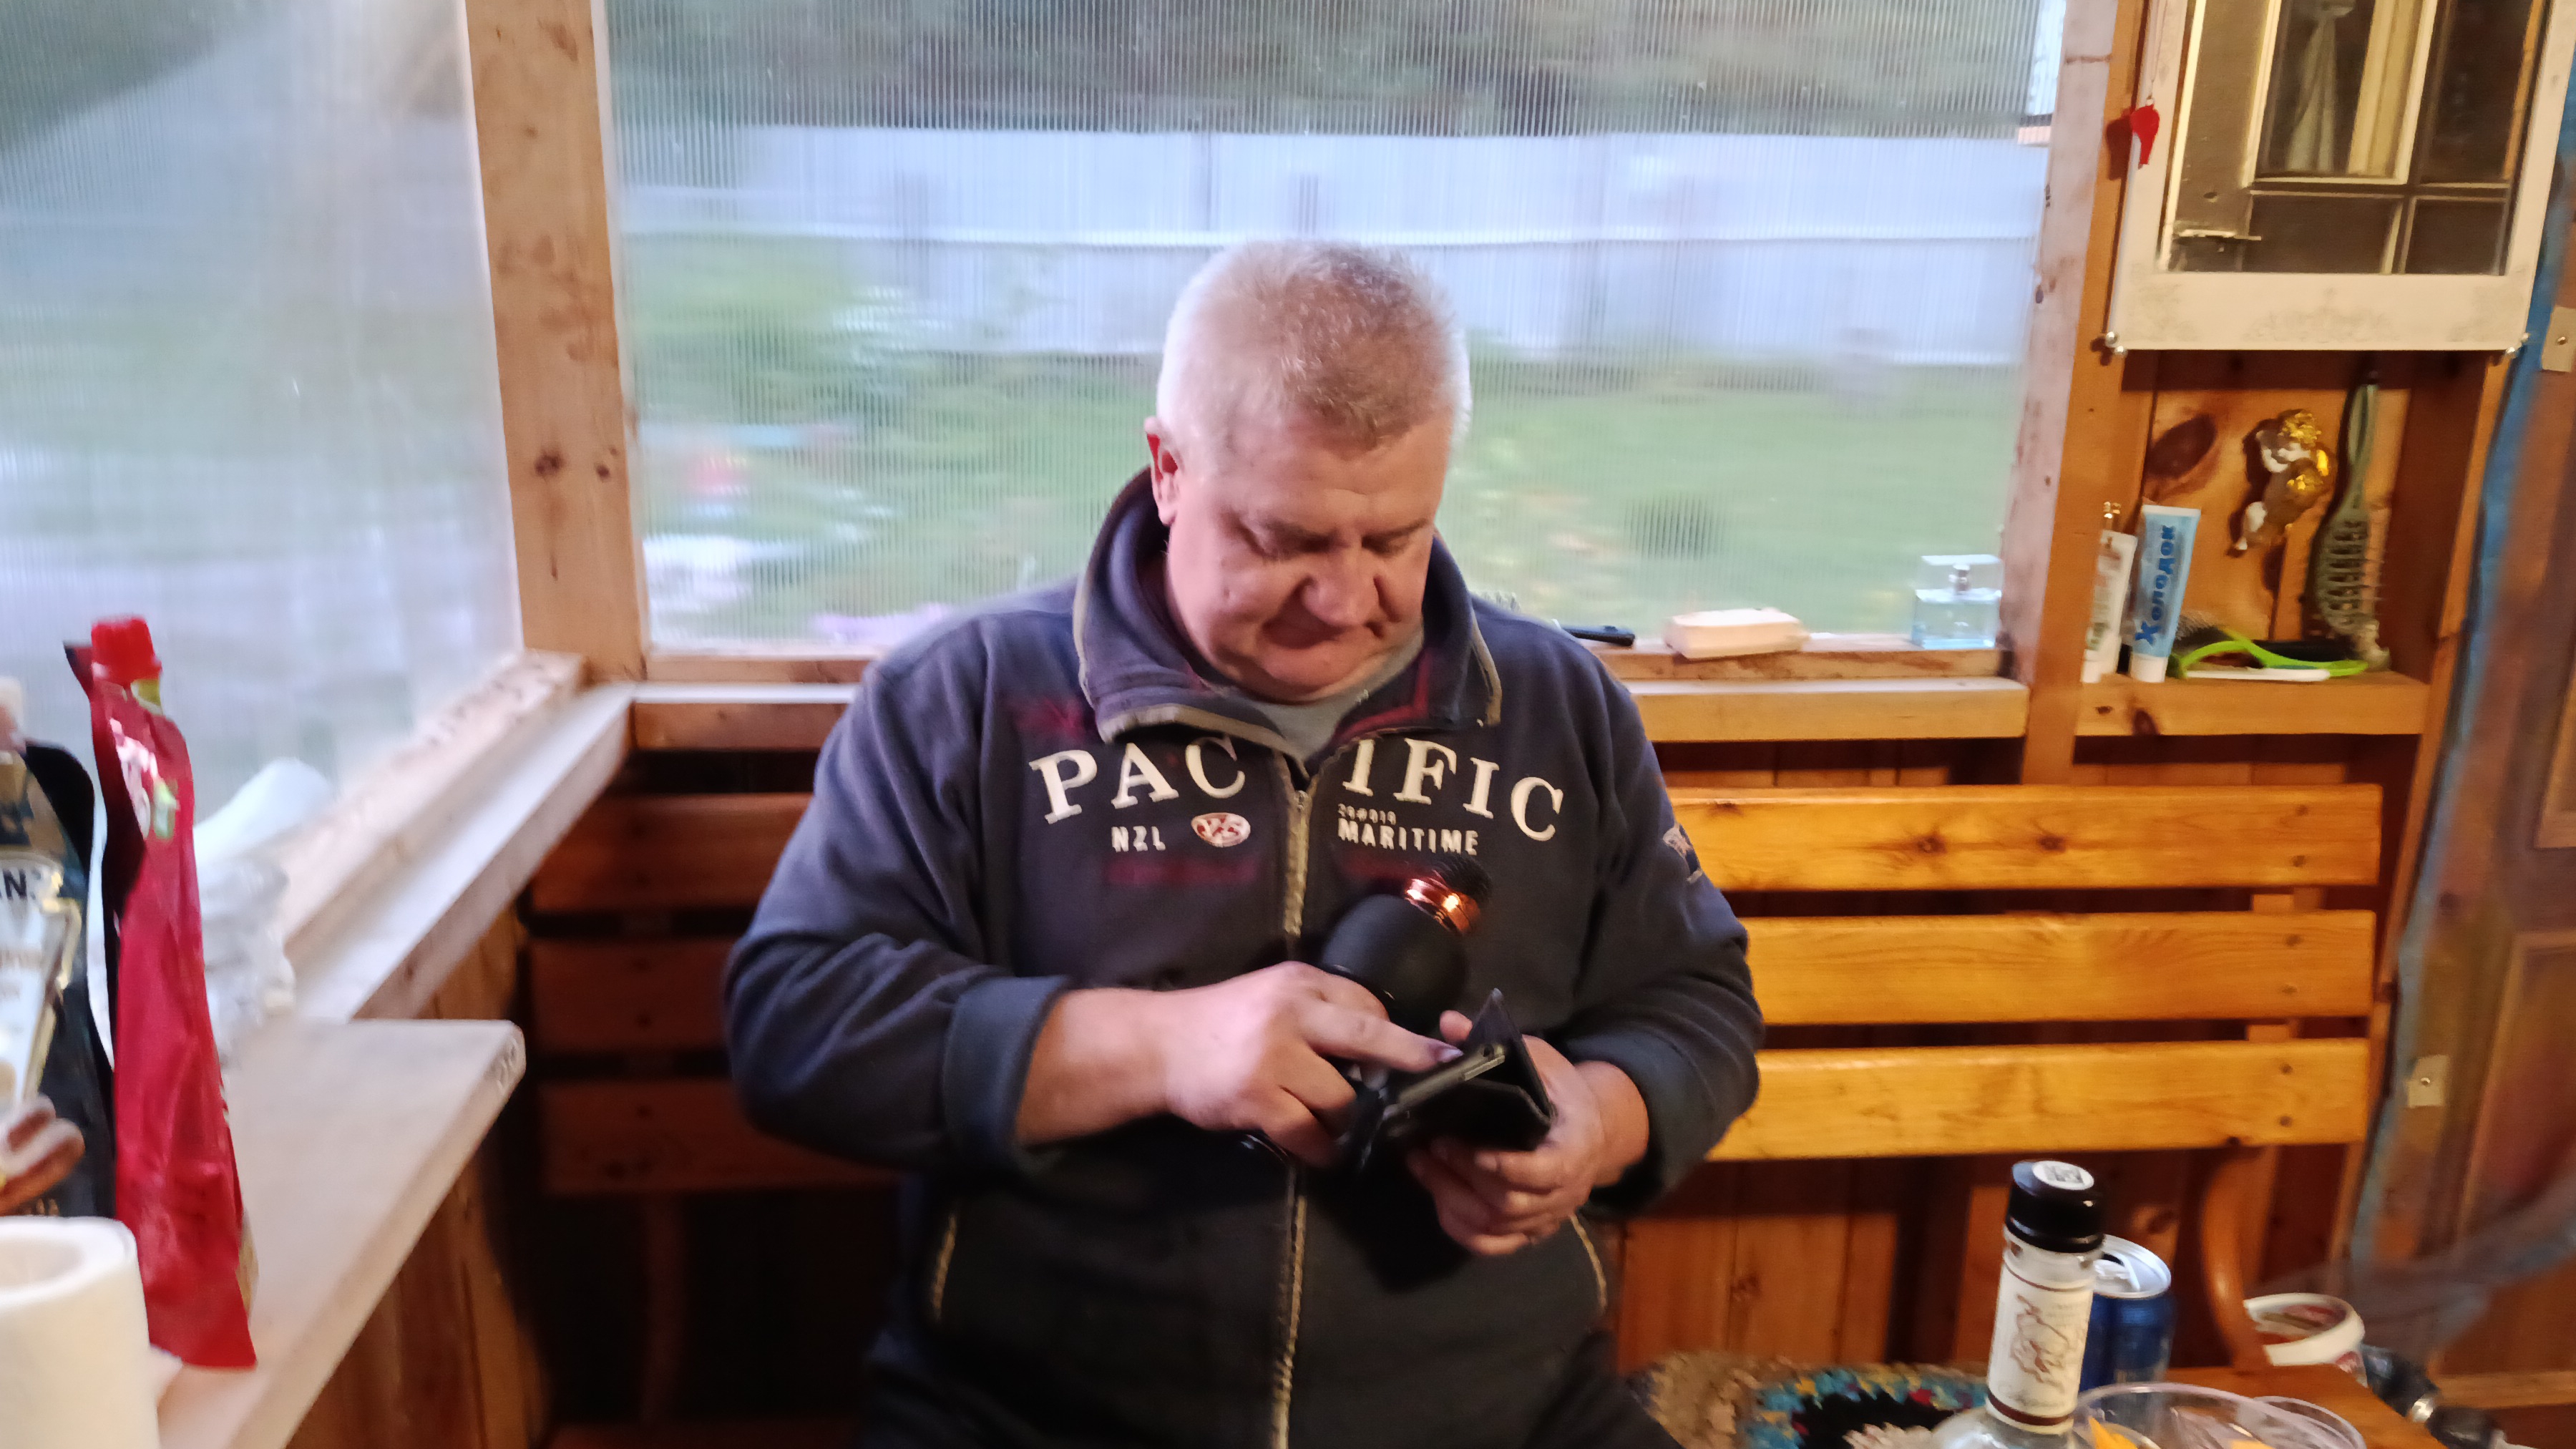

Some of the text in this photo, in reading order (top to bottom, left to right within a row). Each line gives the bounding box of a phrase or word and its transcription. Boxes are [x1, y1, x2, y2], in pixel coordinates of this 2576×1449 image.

[2135, 525, 2176, 645] Холодок
[1111, 826, 1166, 852] NZL
[1337, 817, 1479, 857] MARITIME
